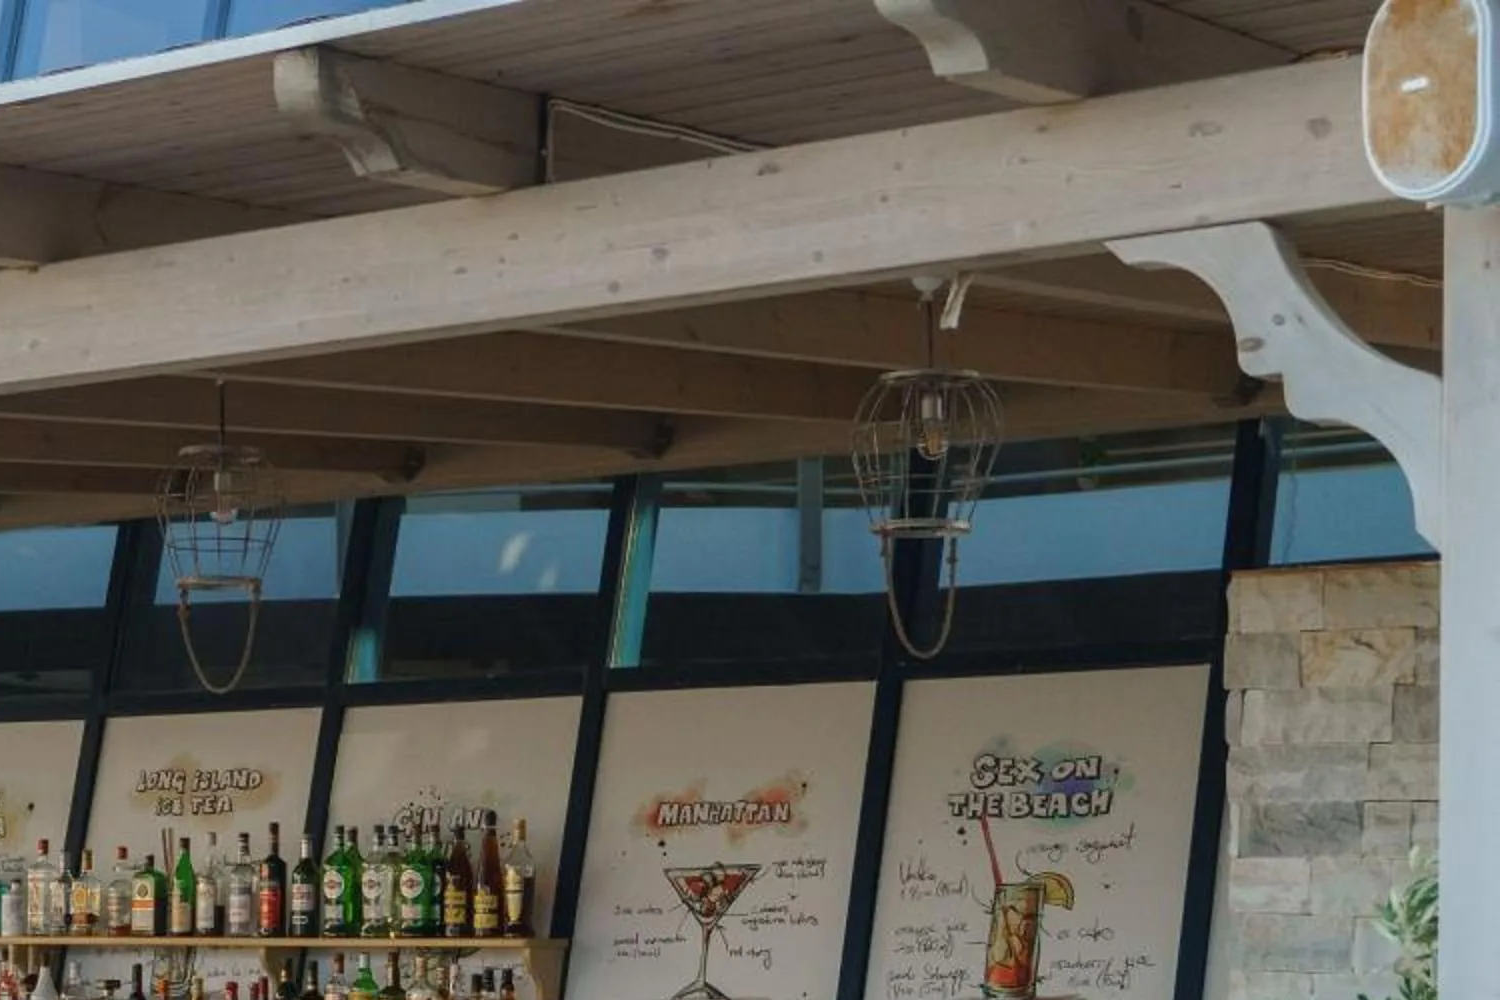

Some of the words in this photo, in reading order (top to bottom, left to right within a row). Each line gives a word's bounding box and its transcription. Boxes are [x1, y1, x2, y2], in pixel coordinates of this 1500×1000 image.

[136, 768, 186, 794] LONG
[970, 753, 1044, 790] SEX
[1051, 755, 1102, 782] ON
[191, 795, 233, 816] TEA
[948, 791, 1004, 820] THE
[1008, 789, 1114, 819] BEACH
